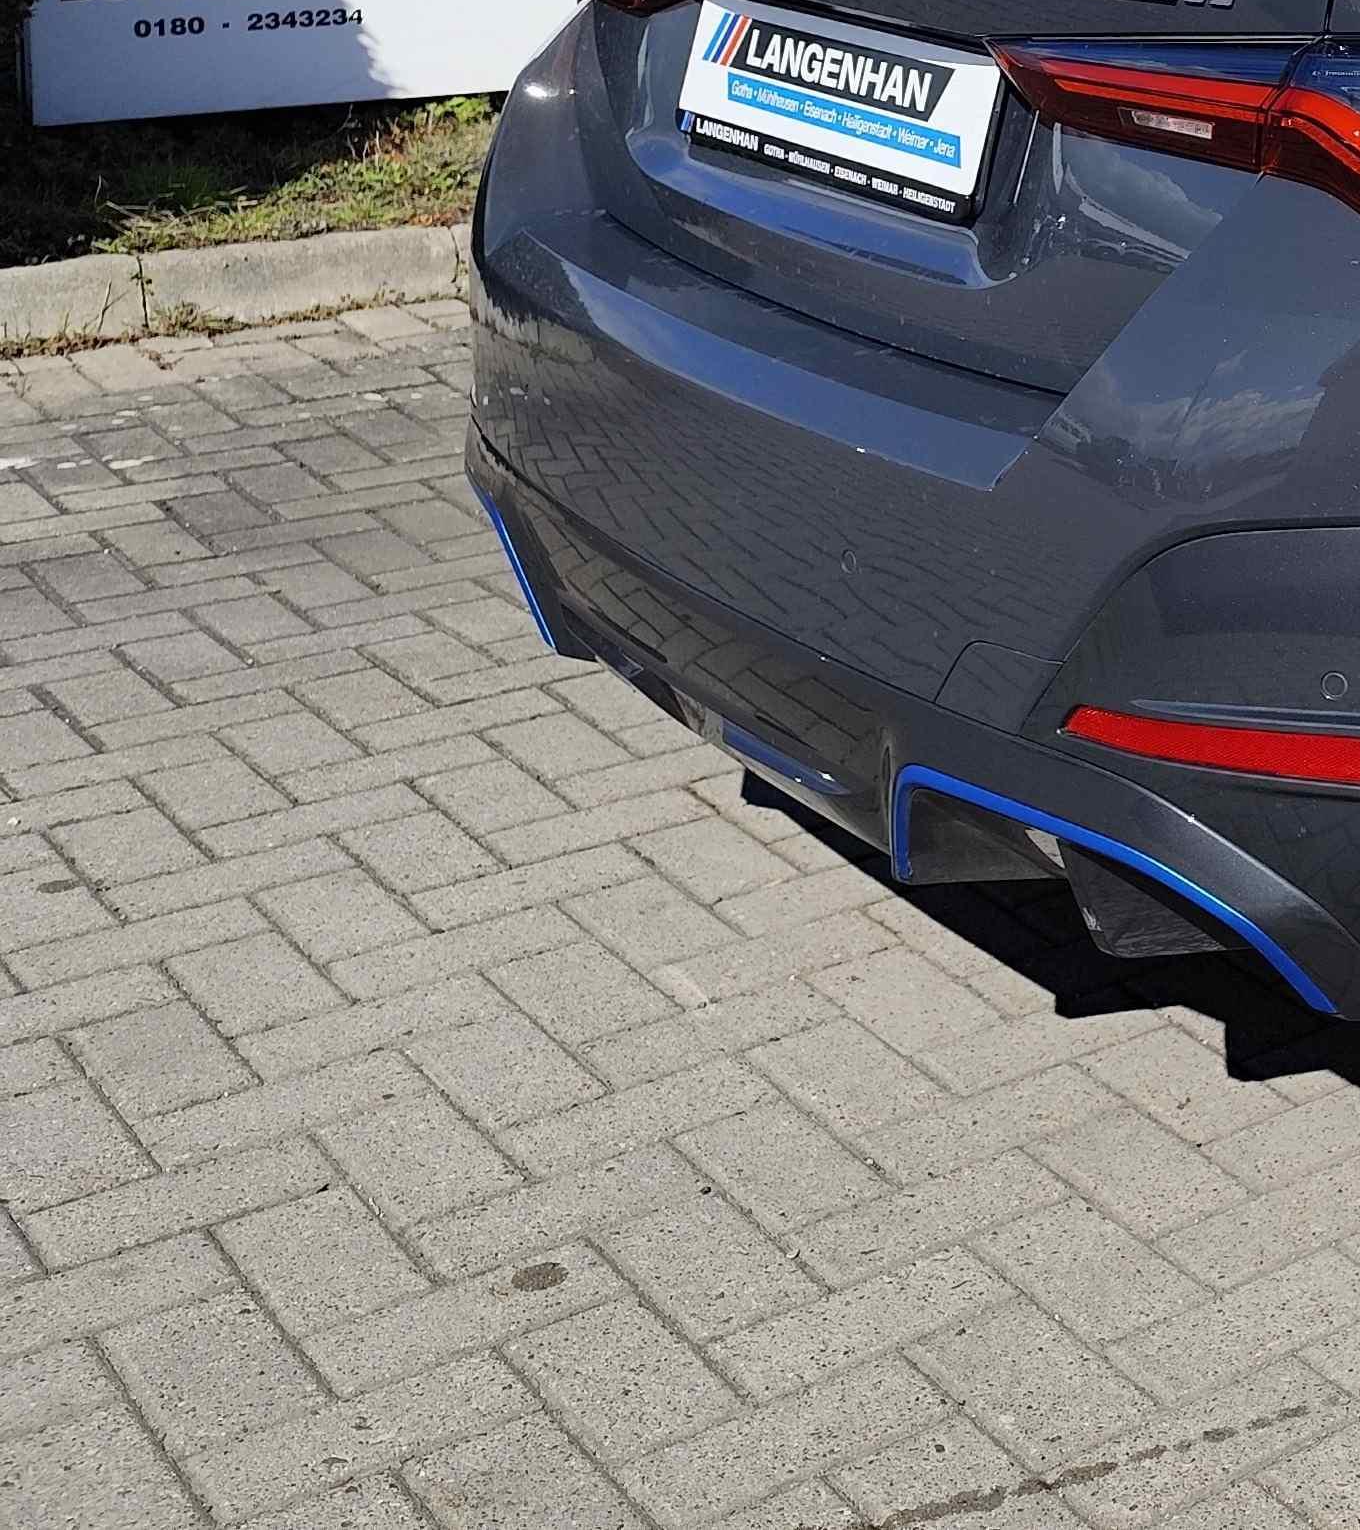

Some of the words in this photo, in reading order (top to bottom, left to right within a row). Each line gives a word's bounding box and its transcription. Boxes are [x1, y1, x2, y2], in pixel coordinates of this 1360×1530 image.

[134, 16, 205, 38] 0180
[247, 9, 363, 32] 2343234
[745, 28, 933, 112] LANGENHAN
[695, 117, 760, 152] LANGENHAN
[764, 143, 785, 160] GOTHA
[731, 80, 753, 100] Gotha
[757, 87, 800, 113] Mühlhausen
[803, 100, 837, 125] Eisenach
[842, 112, 893, 141] Heiligenstadt
[897, 129, 929, 151] Weimar
[933, 138, 956, 158] Jena
